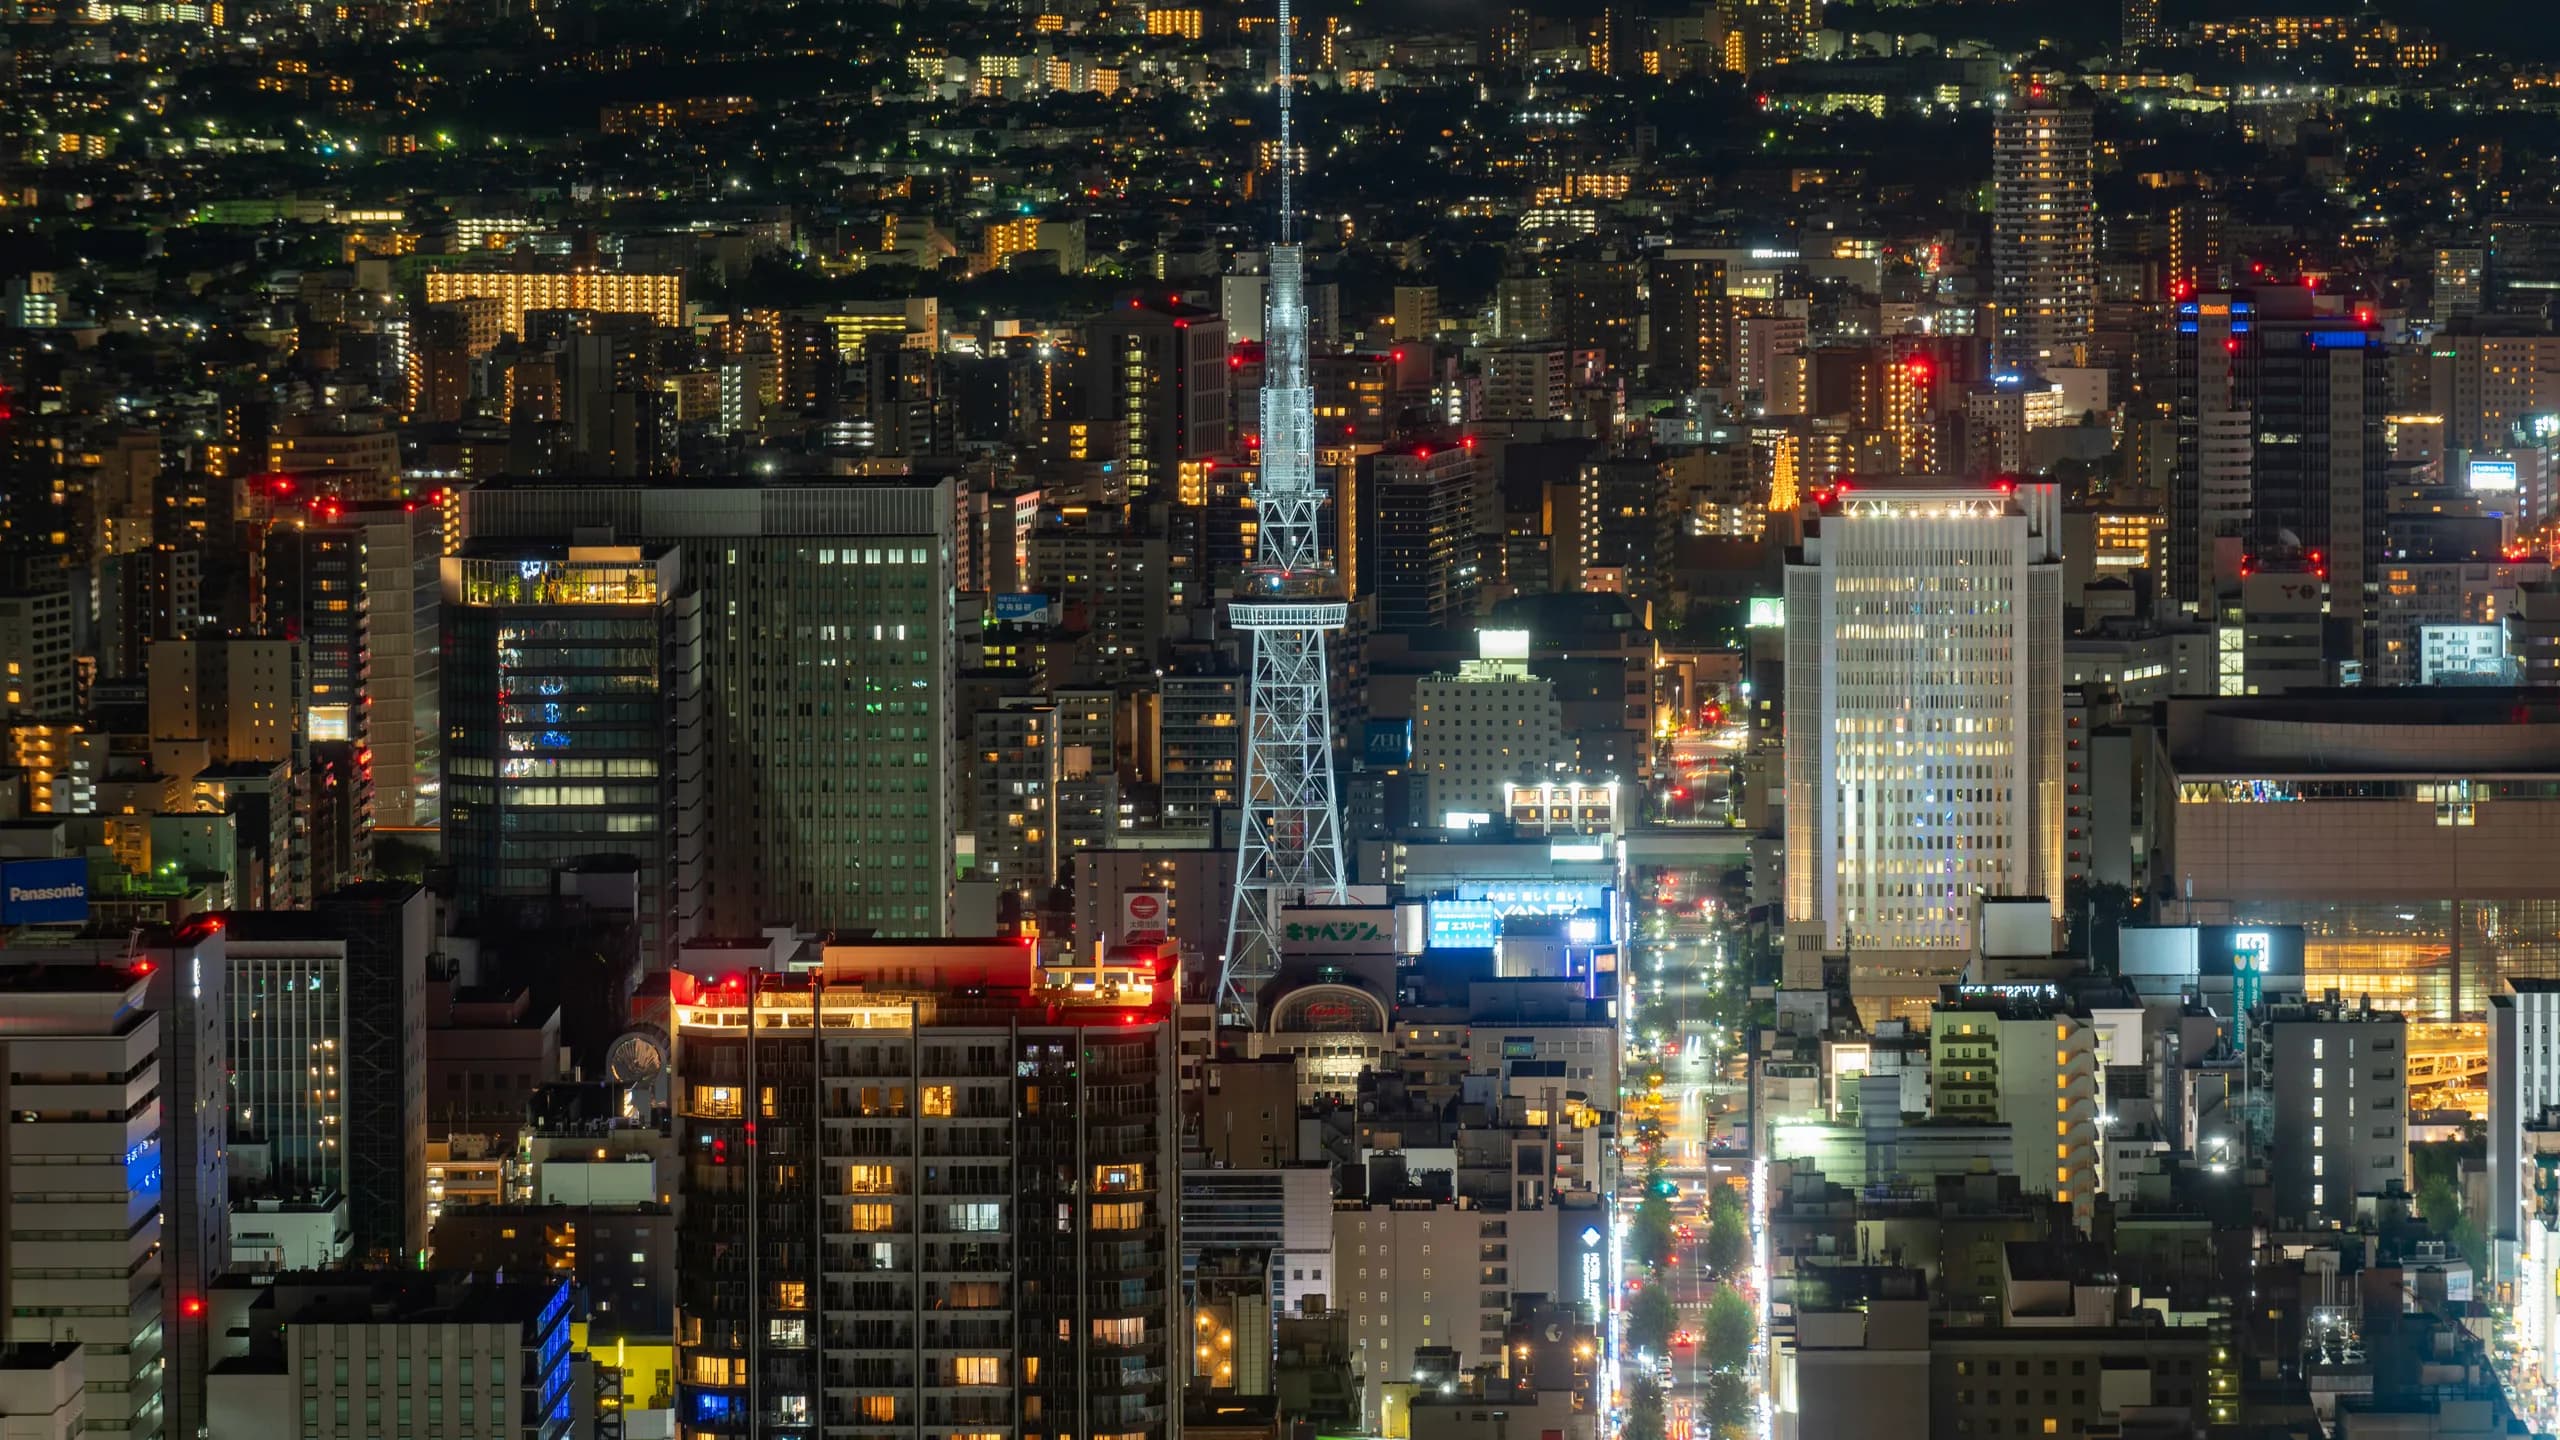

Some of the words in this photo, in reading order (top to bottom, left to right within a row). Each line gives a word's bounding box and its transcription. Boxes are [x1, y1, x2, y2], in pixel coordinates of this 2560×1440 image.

[9, 883, 84, 902] Panasonic
[1286, 922, 1377, 942] キャベジン
[1451, 921, 1490, 931] エスリード
